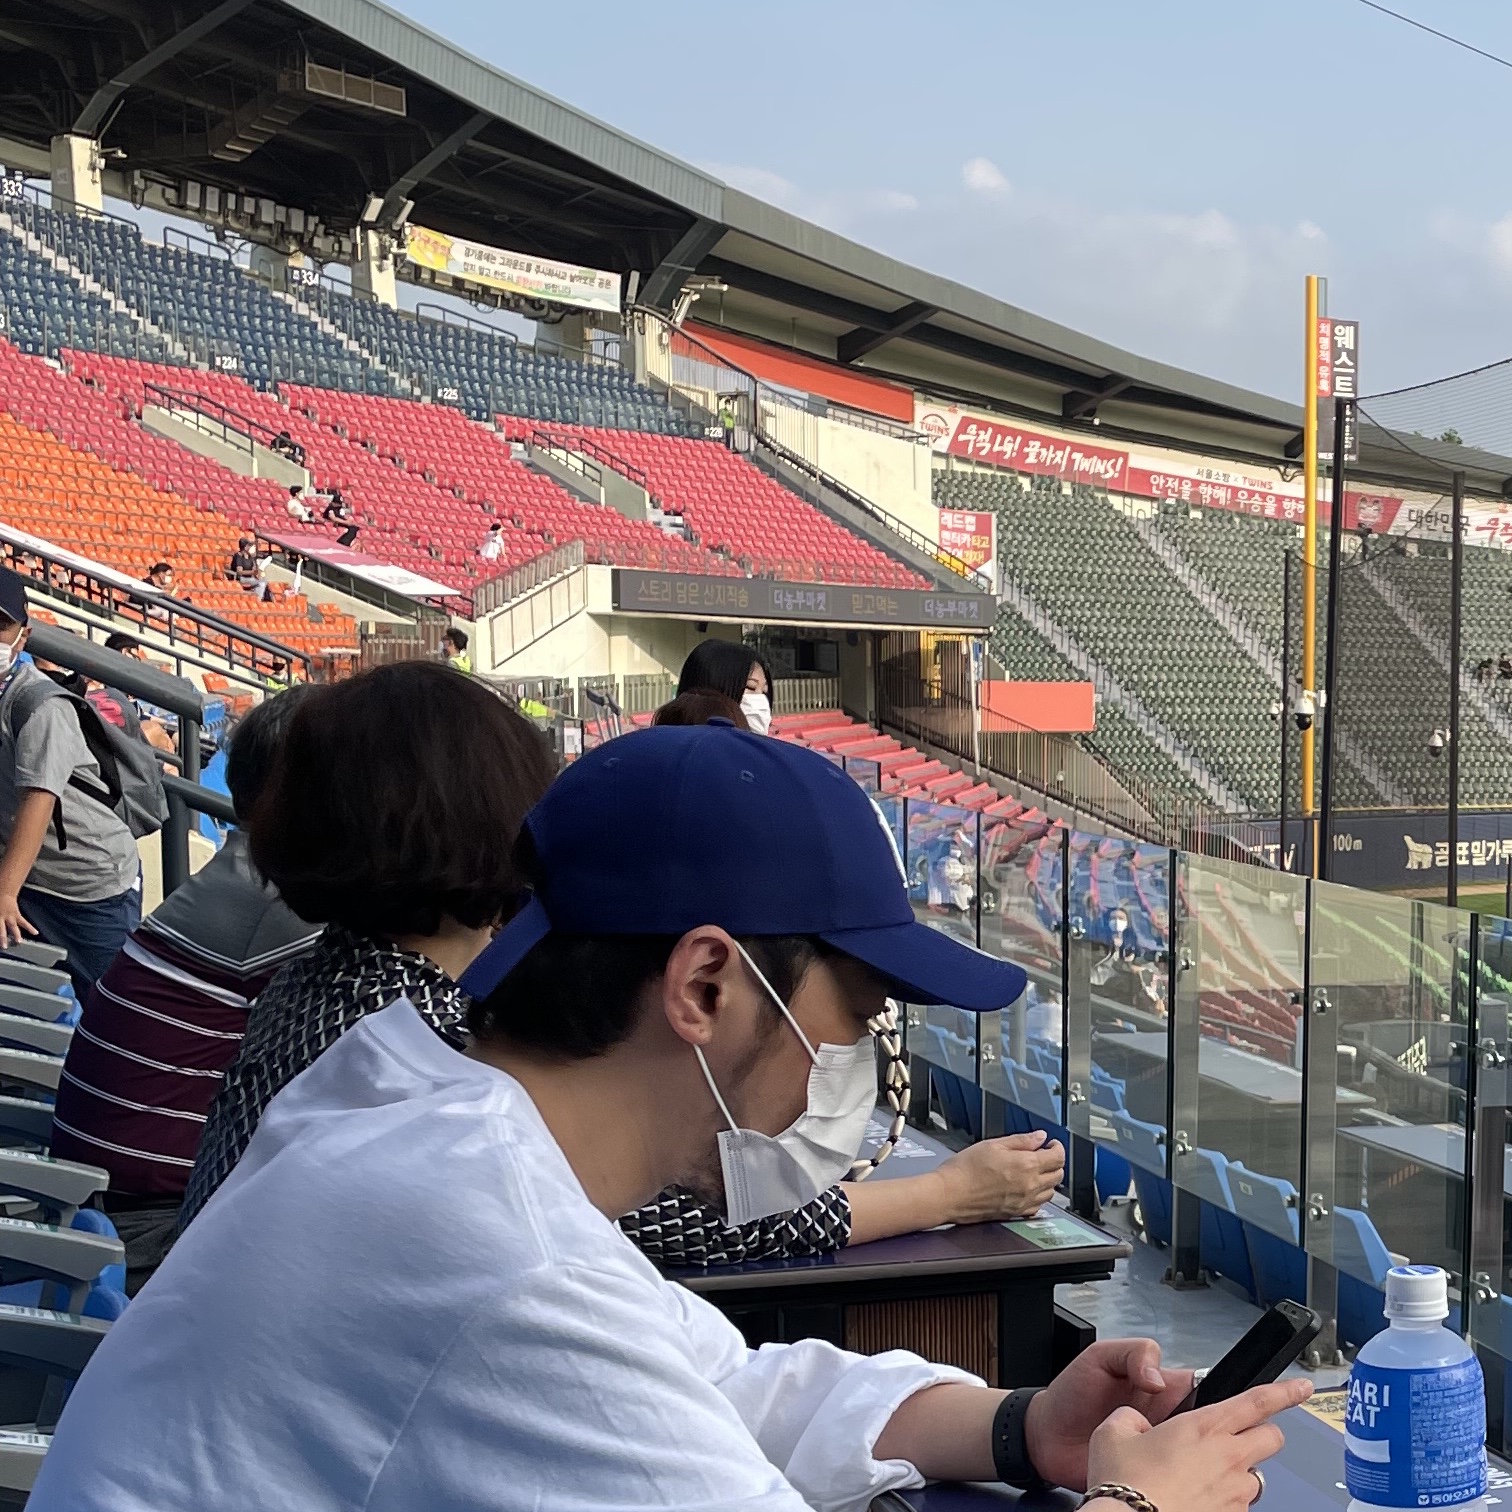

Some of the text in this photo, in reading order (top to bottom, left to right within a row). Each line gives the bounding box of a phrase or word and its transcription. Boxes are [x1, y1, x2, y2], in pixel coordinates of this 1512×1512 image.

[221, 355, 239, 370] 224
[1333, 324, 1356, 398] 웨스트
[957, 424, 993, 456] 무적
[1023, 440, 1071, 473] 끝까지
[1071, 452, 1123, 479] TWINS!
[1150, 474, 1193, 501] 안전을
[1199, 483, 1231, 507] 향해!
[1236, 491, 1277, 516] 우승을
[1242, 476, 1273, 491] TWINS
[637, 579, 750, 610] 스토리 담은 산지직송
